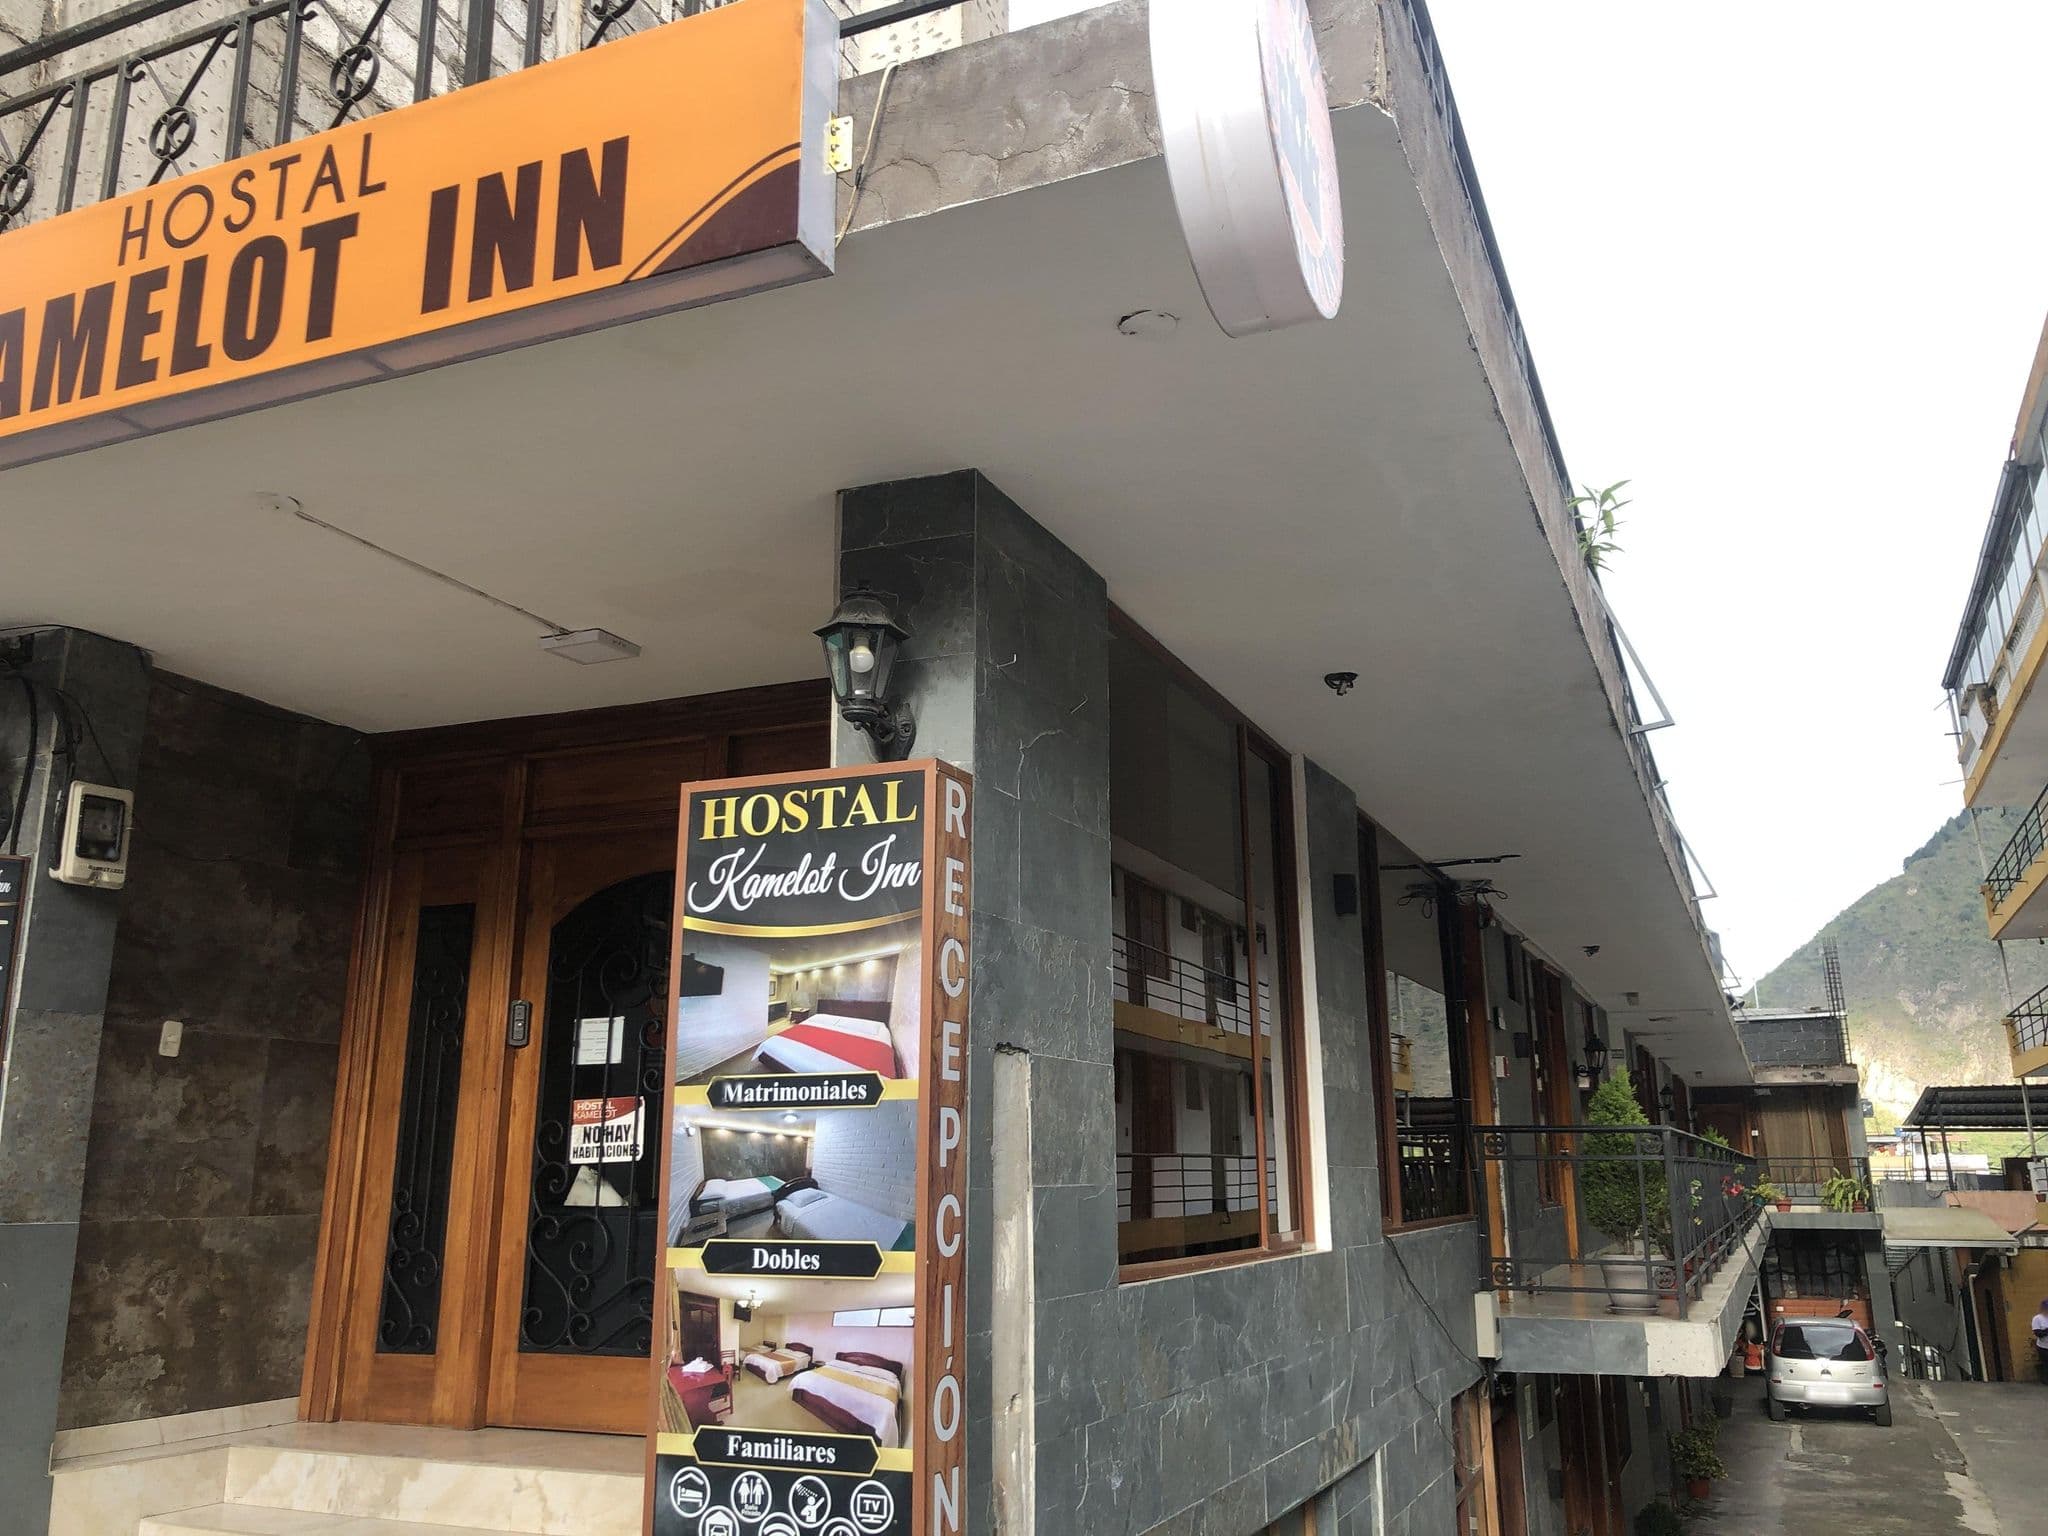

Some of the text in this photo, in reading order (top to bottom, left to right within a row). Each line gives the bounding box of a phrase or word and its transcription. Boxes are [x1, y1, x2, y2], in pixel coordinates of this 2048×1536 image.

[117, 133, 387, 266] HOSTAL
[420, 135, 630, 315] INN
[699, 780, 918, 841] HOSTAL
[687, 834, 922, 913] Kamelot Inn
[723, 1079, 868, 1104] Matrimoniales
[574, 1109, 618, 1118] KAMEOT
[576, 1101, 616, 1110] HOSTL
[583, 1124, 631, 1144] NO HAY
[572, 1144, 640, 1158] HABITCIONES
[752, 1247, 820, 1271] Dobles
[726, 1434, 836, 1464] Familiares
[863, 1499, 881, 1512] TV
